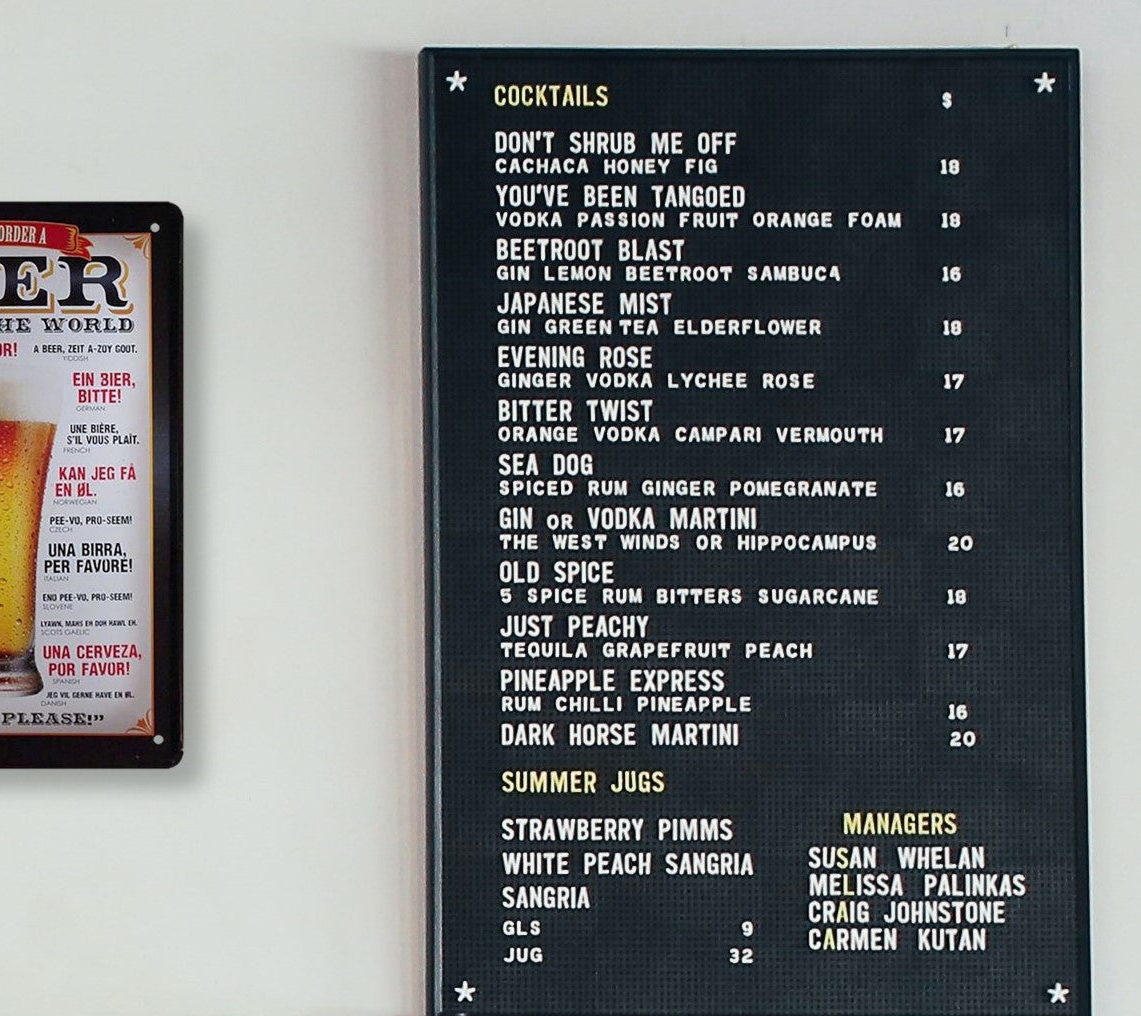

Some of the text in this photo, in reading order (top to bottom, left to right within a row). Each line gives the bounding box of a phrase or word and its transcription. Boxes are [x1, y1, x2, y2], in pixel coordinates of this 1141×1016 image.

[495, 85, 608, 106] COCKTAILS
[495, 131, 736, 154] DON'T SHRUB ME OFF
[496, 158, 959, 175] CACHACA HONEY FIG 18
[496, 184, 745, 208] YOU'VE BEEN TANGOED
[37, 227, 47, 244] A
[497, 239, 684, 261] BEETROOT BLAST
[497, 266, 961, 282] GIN LEMON BEETROOT SAMBUCA 16
[497, 292, 671, 315] JAPANESE MIST
[43, 317, 135, 334] WORLD
[498, 346, 652, 369] EVENING ROSE
[73, 372, 135, 388] EIN BIER,
[78, 389, 121, 403] BITTE!
[499, 400, 652, 422] BITTER TWIST
[59, 466, 86, 481] KAN
[91, 466, 115, 481] JEG
[499, 454, 593, 475] SEA DOG
[55, 483, 72, 497] EN
[500, 507, 756, 530] GIN OR VODKA MARTINI
[48, 542, 127, 558] UNA BIRRA,
[44, 558, 132, 574] PER FAVORE!
[500, 561, 614, 583] OLD SPICE
[500, 615, 648, 638] JUST PEACHY
[43, 644, 142, 660] UNA CERVEZA,
[48, 661, 130, 677] POR FAVOR!
[501, 669, 724, 692] PINEAPPLE EXPRESS
[502, 723, 976, 747] DARK HORSE MARTINI 20
[502, 771, 664, 793] SUMMER JUGS
[502, 818, 733, 841] STRAWBERRY PIMMS
[844, 813, 957, 835] MANAGERS
[503, 852, 753, 875] WHITE PEACH SANGRIA
[809, 846, 984, 869] SUSAN WHELAN
[810, 874, 1026, 897] MELISSA PALINKAS
[503, 886, 590, 909] SANGRIA
[809, 901, 1005, 924] CRAIG JOHNSTONE
[503, 921, 753, 936] GLS 9
[809, 928, 986, 951] CARMEN KUTAN
[504, 947, 753, 963] JUG 32
